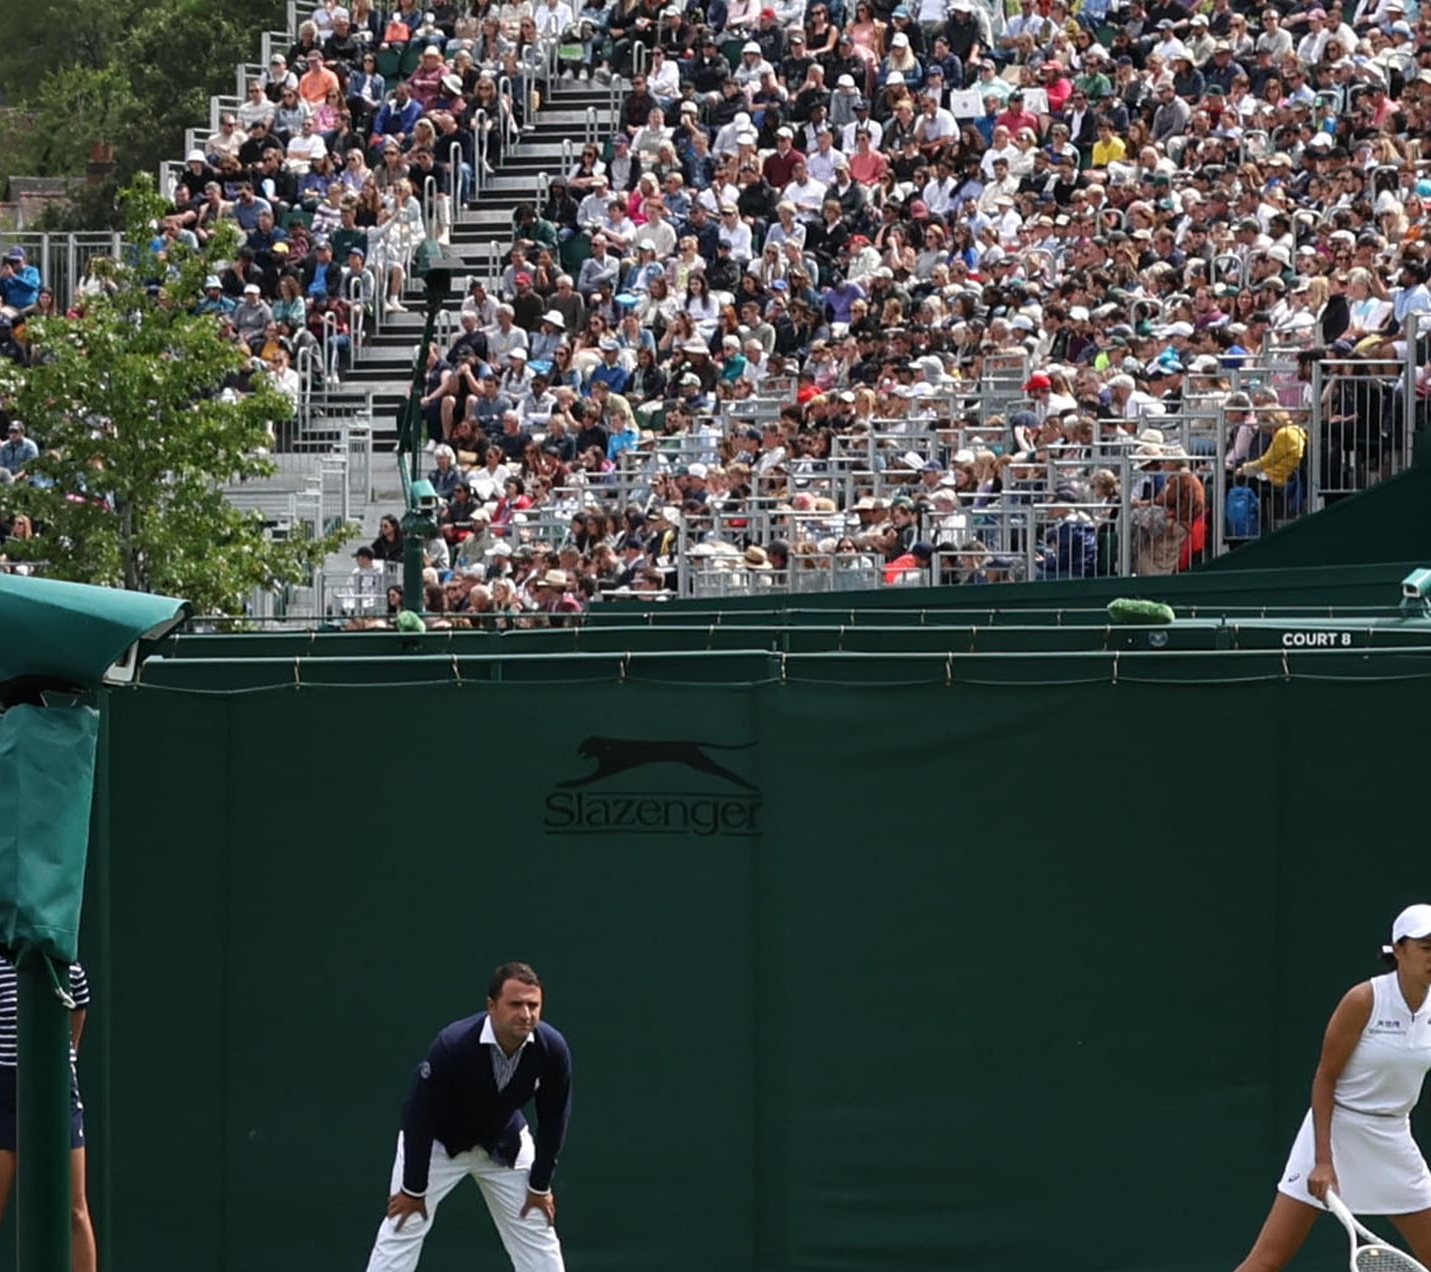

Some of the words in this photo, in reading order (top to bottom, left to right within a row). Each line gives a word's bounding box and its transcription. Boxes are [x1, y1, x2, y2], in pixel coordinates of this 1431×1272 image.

[1282, 632, 1337, 647] COURT
[1341, 632, 1352, 646] 8
[544, 792, 764, 837] Slazenger
